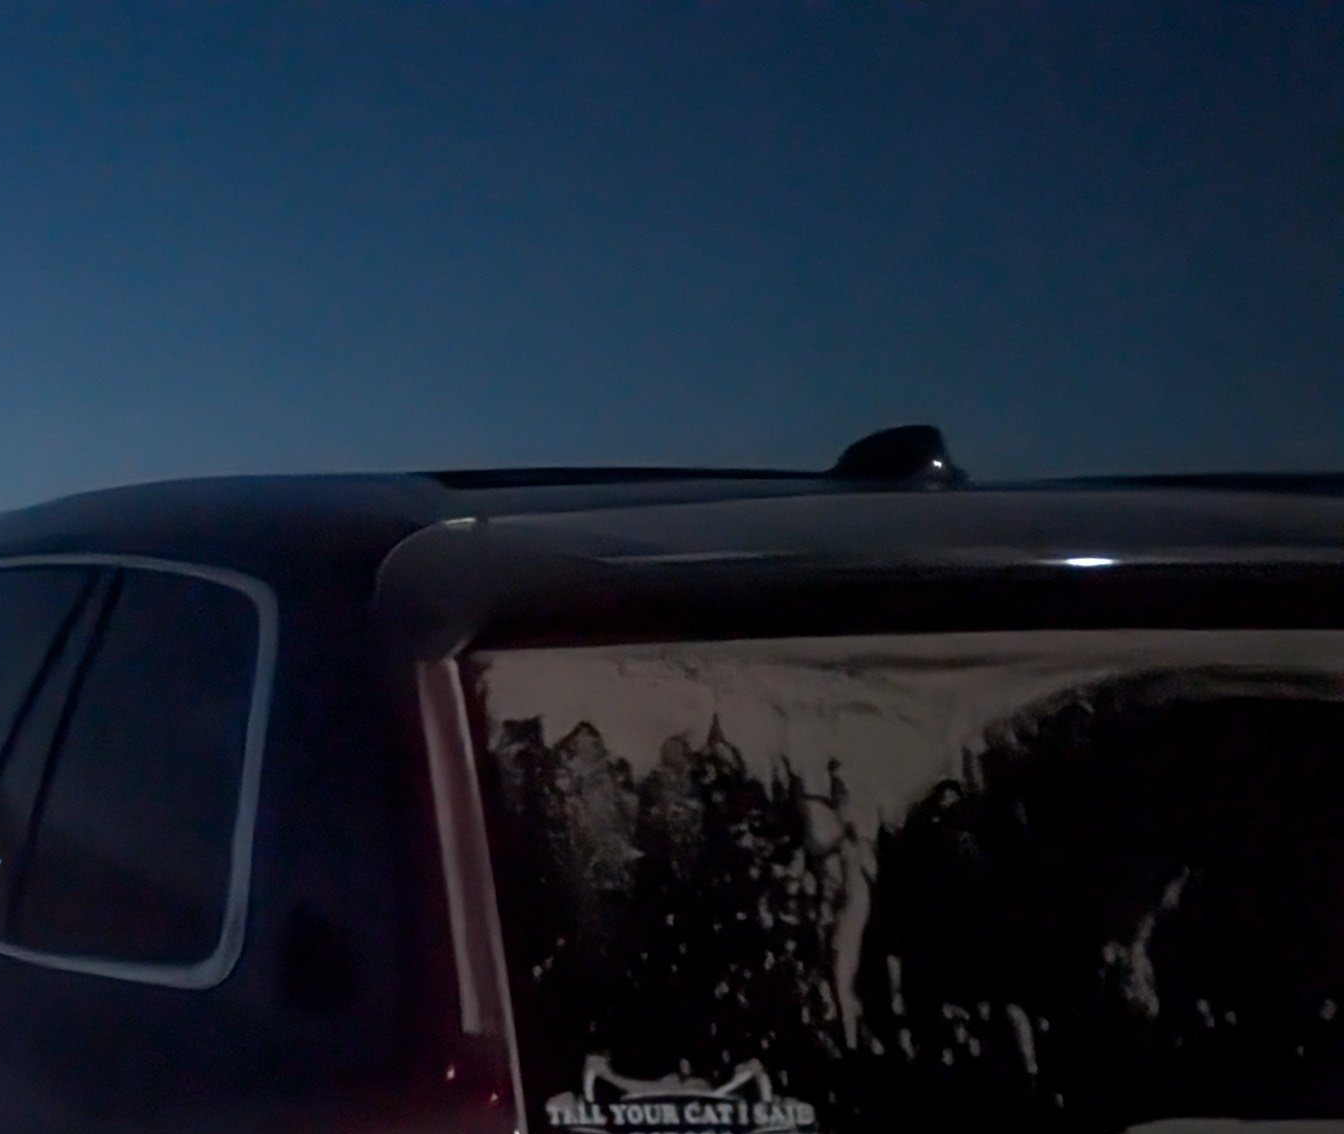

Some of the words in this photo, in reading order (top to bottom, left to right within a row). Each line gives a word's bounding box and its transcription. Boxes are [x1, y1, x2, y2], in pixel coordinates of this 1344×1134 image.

[548, 1103, 606, 1126] TELL
[610, 1102, 680, 1126] YOUR
[684, 1102, 733, 1126] CAT
[738, 1102, 748, 1125] I
[752, 1102, 815, 1126] SAID
